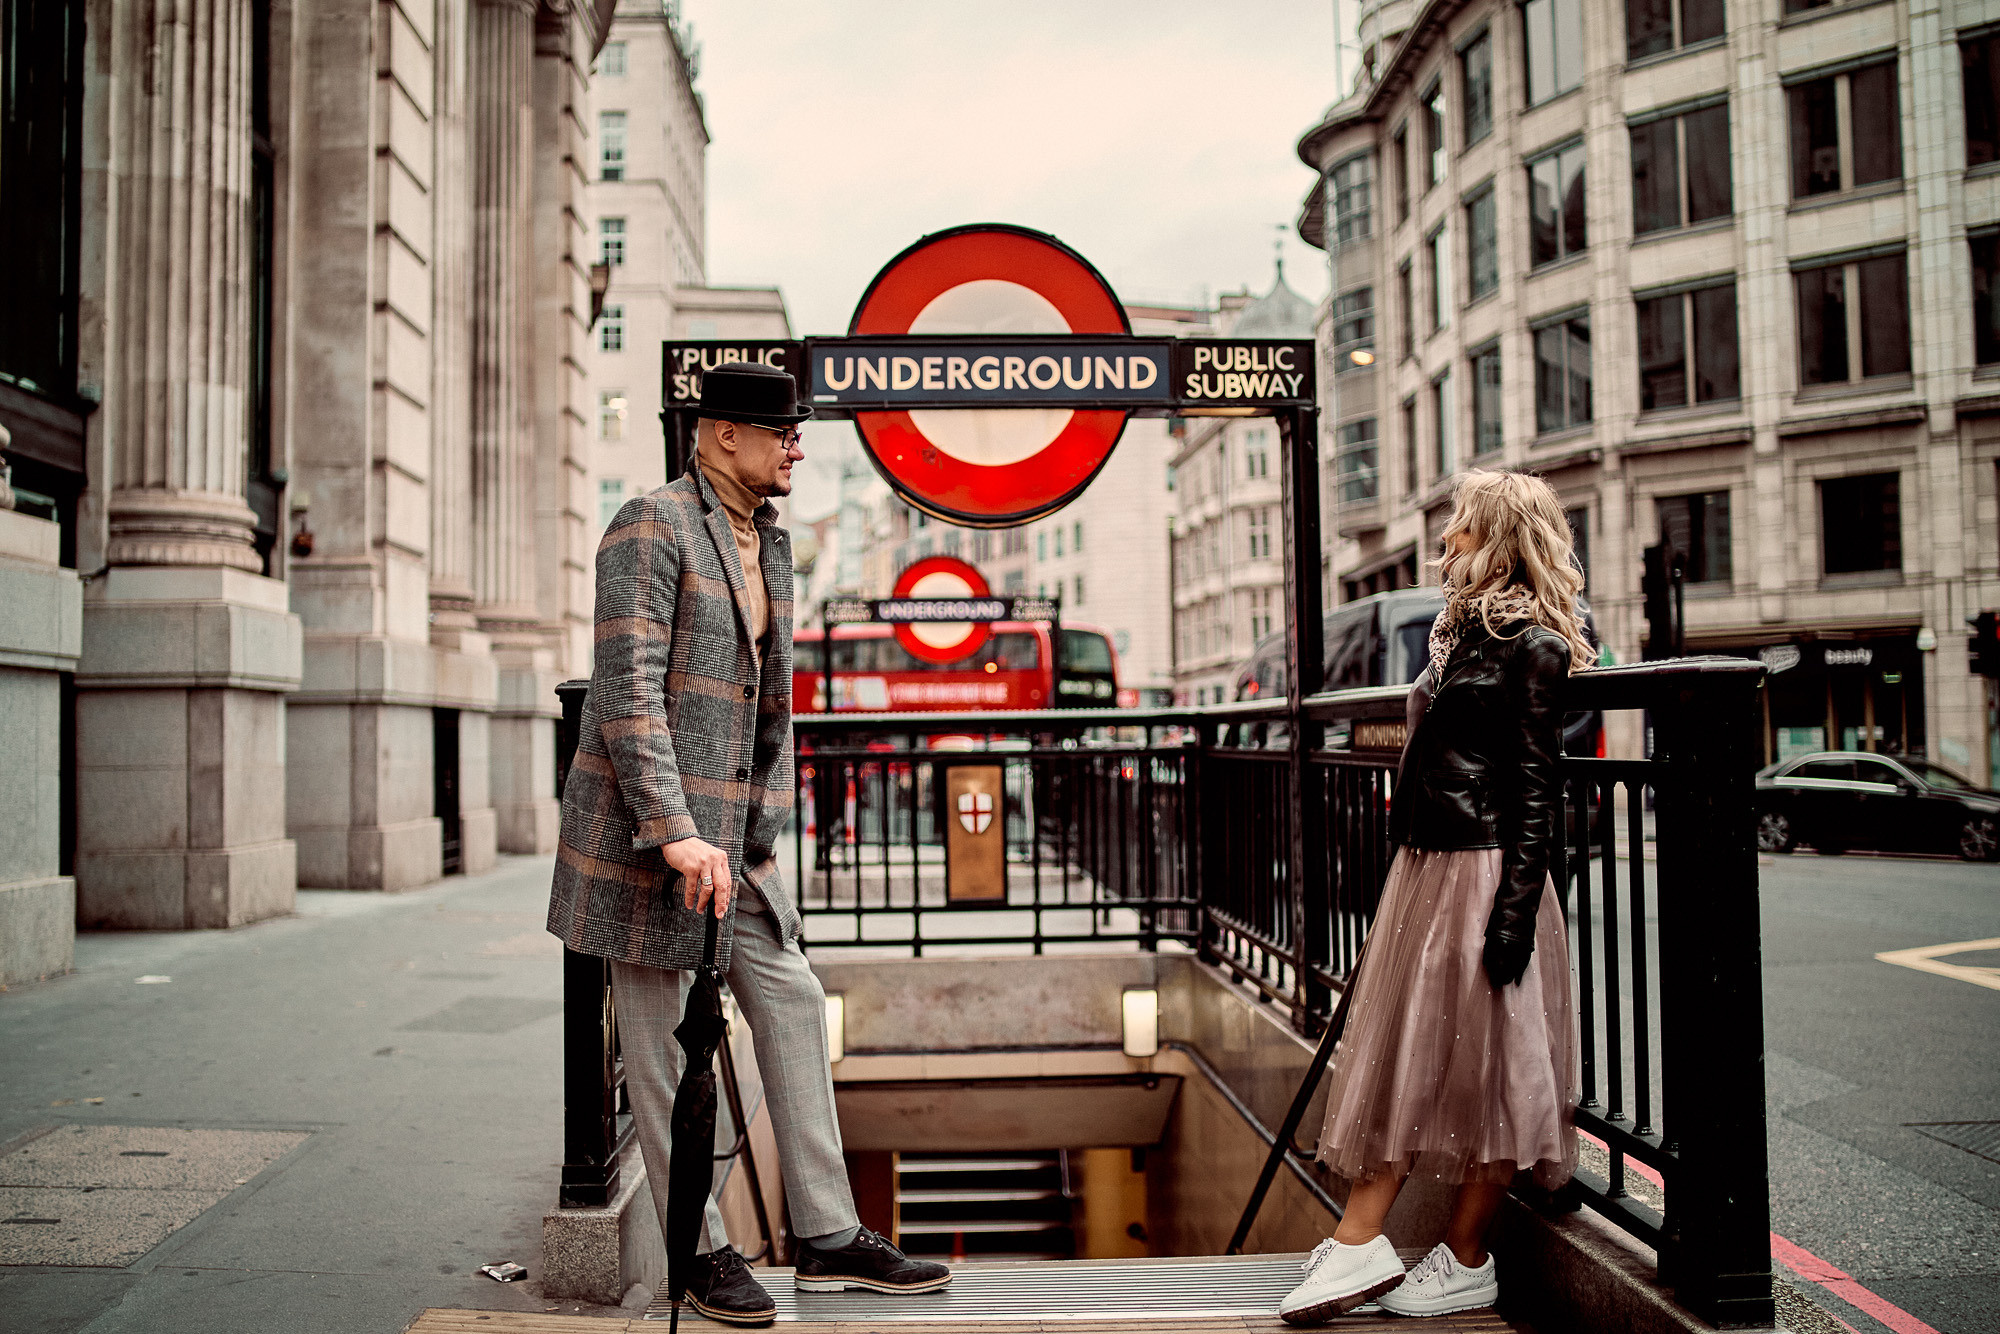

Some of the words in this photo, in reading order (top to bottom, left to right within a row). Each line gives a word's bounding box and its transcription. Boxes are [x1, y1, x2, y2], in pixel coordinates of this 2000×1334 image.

[1194, 346, 1295, 371] PUBLIC
[824, 356, 1158, 391] UNDERGROUND
[1185, 373, 1304, 399] SUBWAY
[879, 601, 1005, 619] UNDERGROUND
[1362, 725, 1408, 746] MONUMEN
